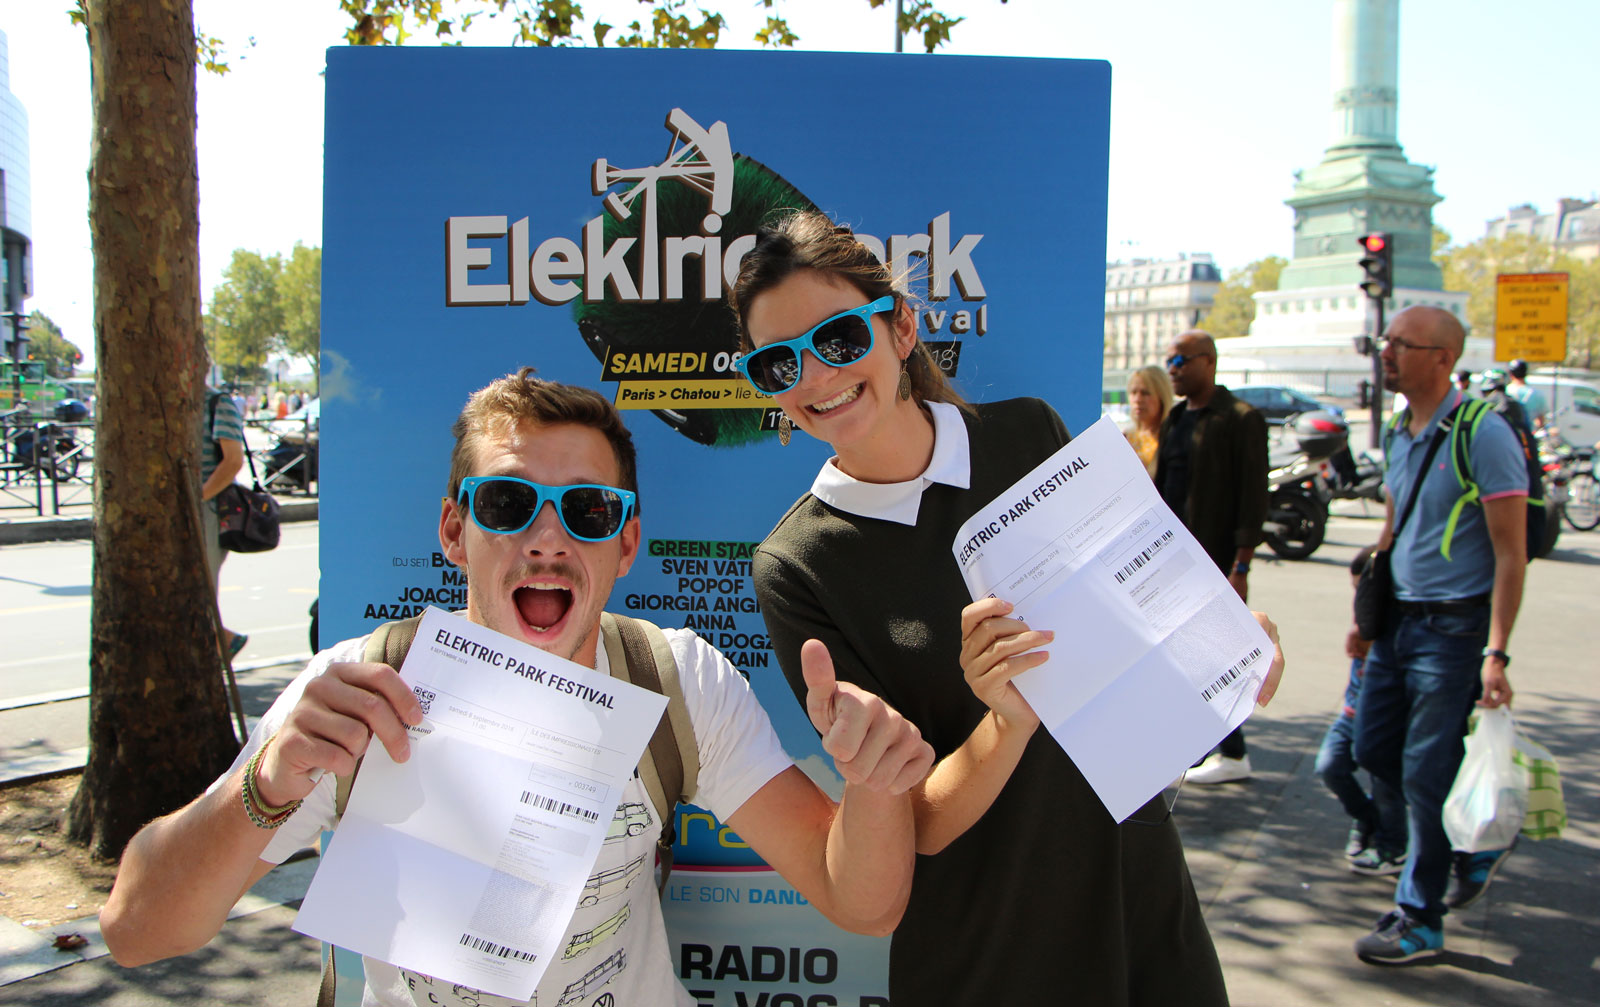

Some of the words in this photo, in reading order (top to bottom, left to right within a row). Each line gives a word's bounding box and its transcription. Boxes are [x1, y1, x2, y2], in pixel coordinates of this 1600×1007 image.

[913, 303, 988, 337] ival
[610, 352, 707, 374] SAMEDI
[622, 389, 655, 400] Paris
[670, 387, 720, 400] Chatou
[959, 522, 1001, 566] ELEKTRIC
[998, 496, 1035, 527] PARK
[1032, 457, 1090, 502] FESTIVAL
[649, 540, 711, 557] GREEN
[393, 556, 408, 567] (DJ
[410, 558, 429, 568] SET)
[662, 559, 708, 574] SVEN
[678, 578, 744, 594] POPOF
[625, 594, 709, 611] GIORGIA
[683, 614, 737, 631] ANNA
[435, 629, 504, 667] ELEKTRIC
[505, 657, 548, 685] PARK
[547, 674, 614, 710] FESTIVAL
[412, 726, 432, 735] RADIO
[574, 781, 597, 794] 003749
[671, 886, 692, 902] LE
[700, 887, 740, 903] SON
[681, 943, 838, 985] RADIO
